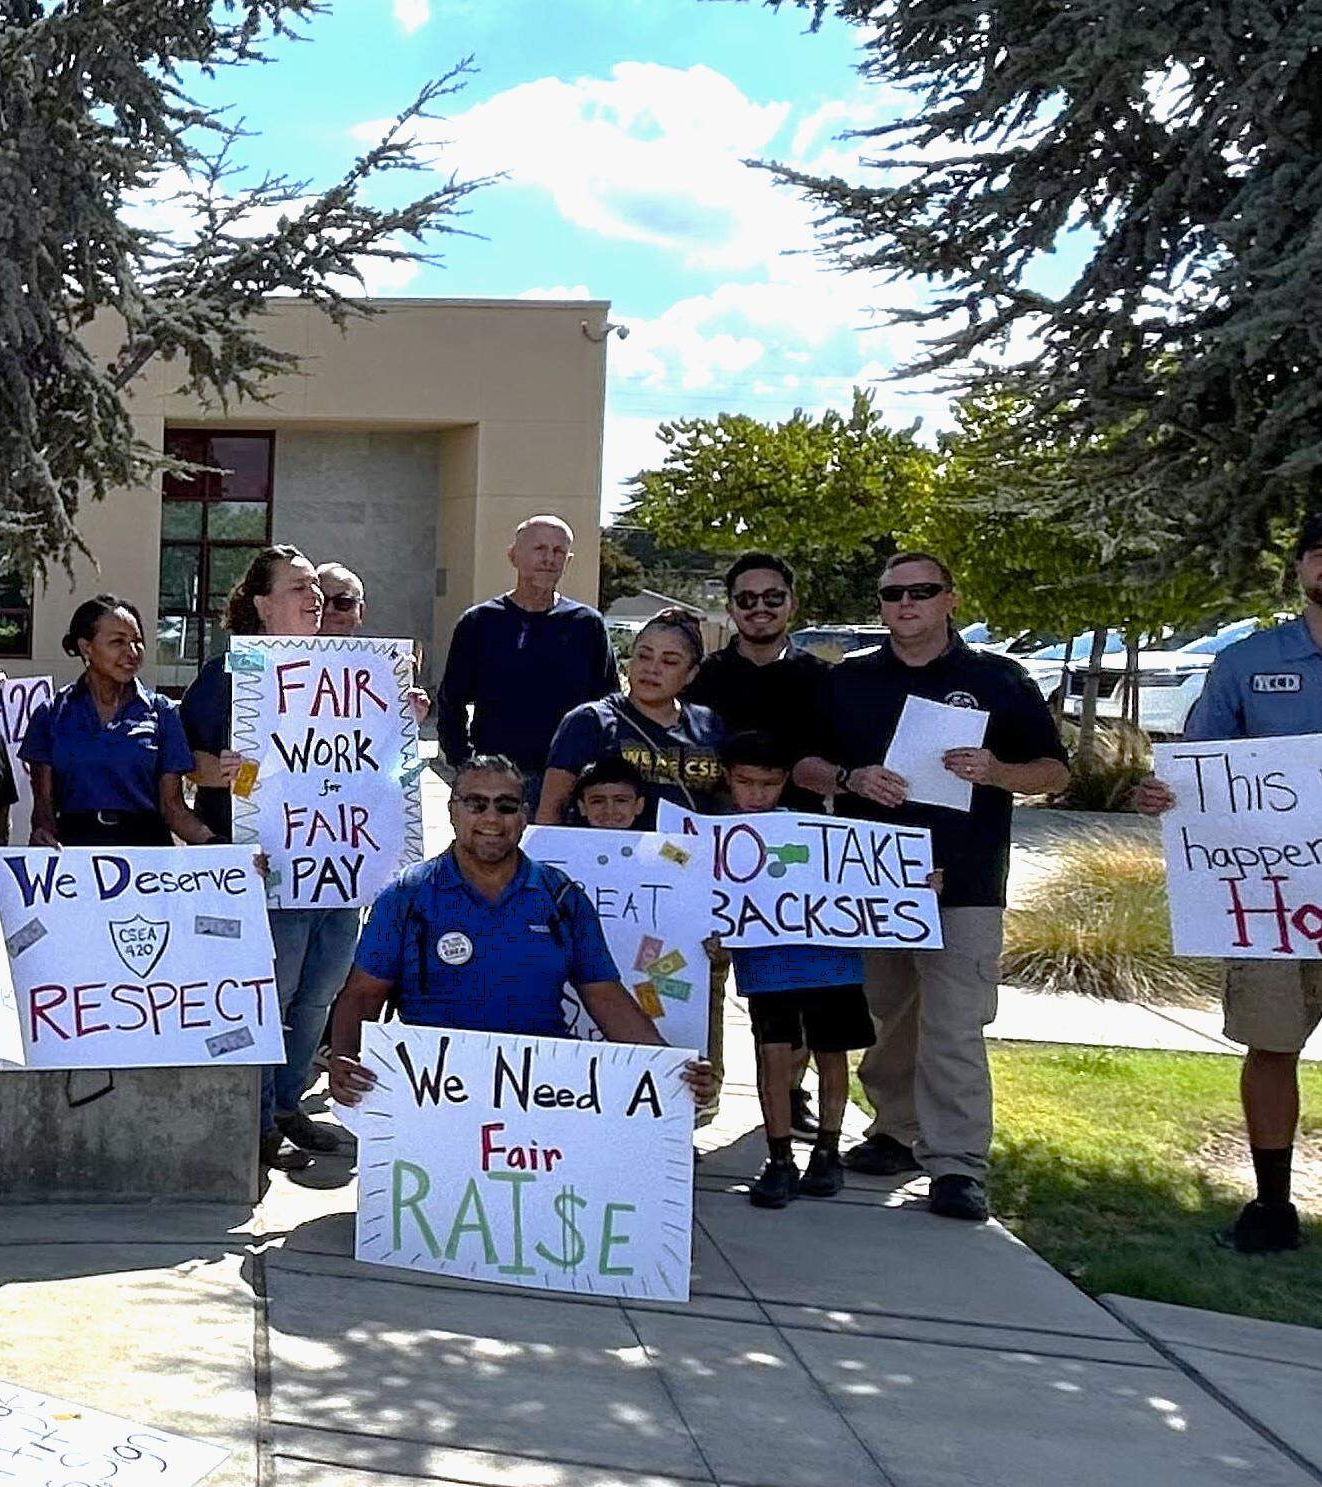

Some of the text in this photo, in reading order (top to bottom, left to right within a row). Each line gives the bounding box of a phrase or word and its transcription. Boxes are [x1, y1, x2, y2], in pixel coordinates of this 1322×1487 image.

[276, 660, 388, 718] FAIR
[271, 727, 379, 774] WORK
[318, 779, 342, 796] for
[1173, 752, 1299, 813] This
[284, 802, 381, 851] FAIR
[3, 855, 78, 907] We
[92, 854, 248, 901] Deserve
[293, 854, 365, 903] PAY
[798, 821, 932, 889] TAKE
[578, 880, 674, 930] EAT
[711, 889, 932, 943] BACKSIES
[118, 926, 158, 944] CSEA
[29, 977, 276, 1044] RESPECT
[395, 1036, 663, 1119] We Need A
[480, 1122, 564, 1173] Fair
